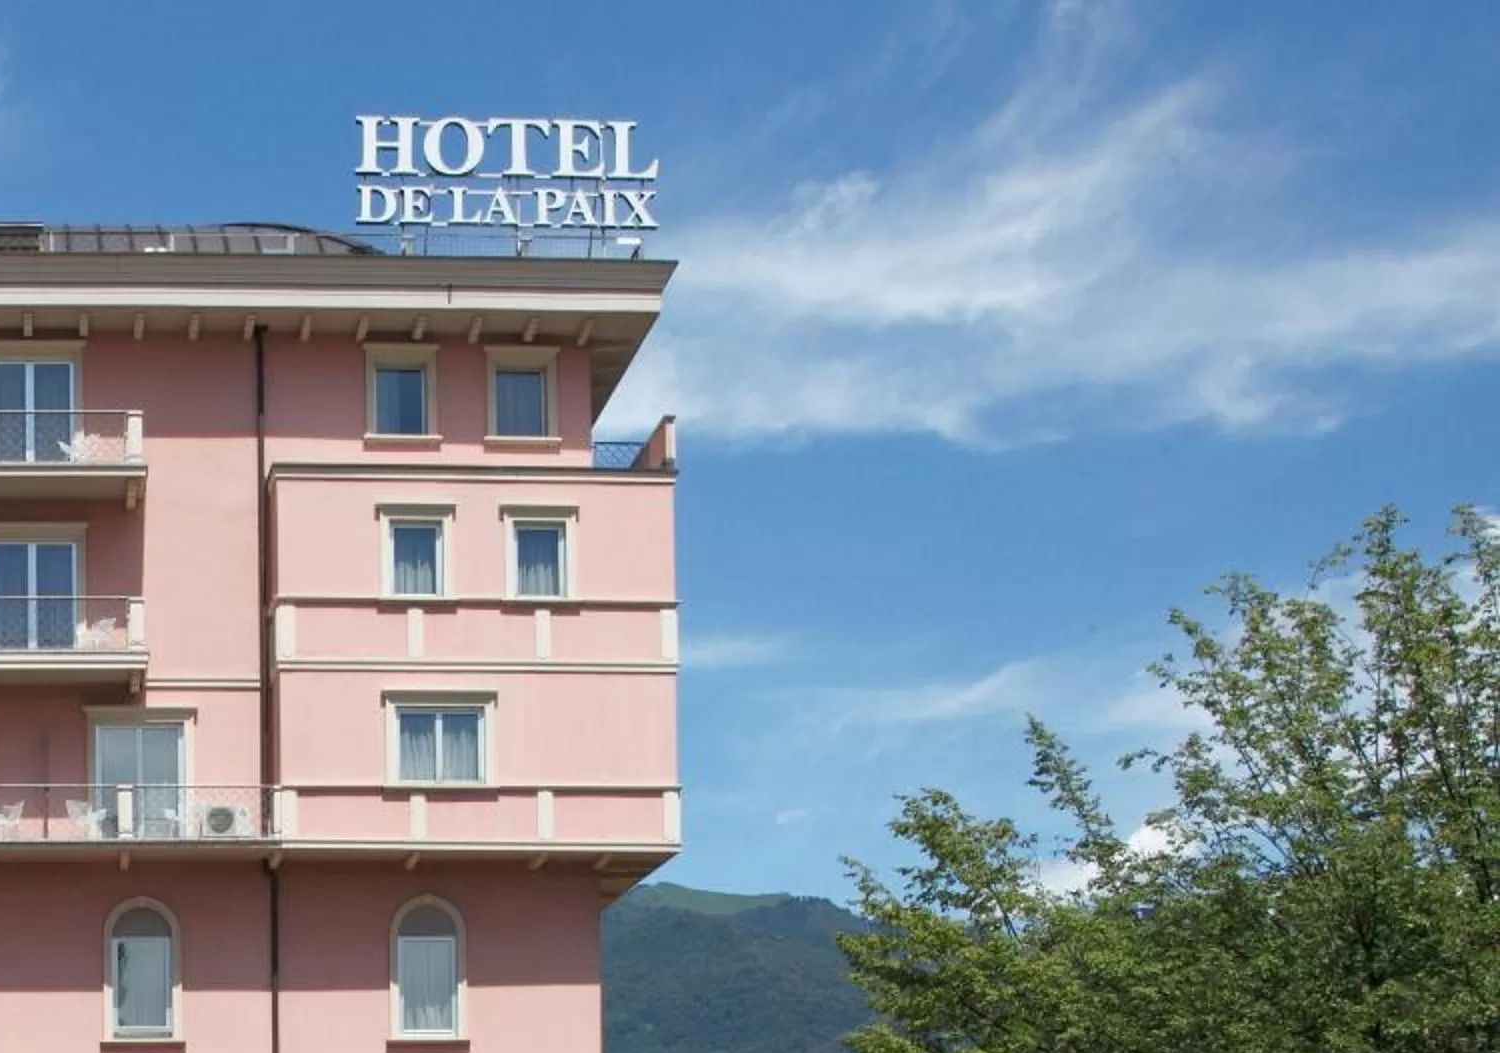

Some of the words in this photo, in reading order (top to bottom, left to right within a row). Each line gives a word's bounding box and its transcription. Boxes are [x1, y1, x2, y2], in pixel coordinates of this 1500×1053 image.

[355, 115, 659, 180] HOTEL
[356, 184, 434, 226] DE
[448, 186, 518, 227] LA
[534, 188, 660, 229] PAIX
